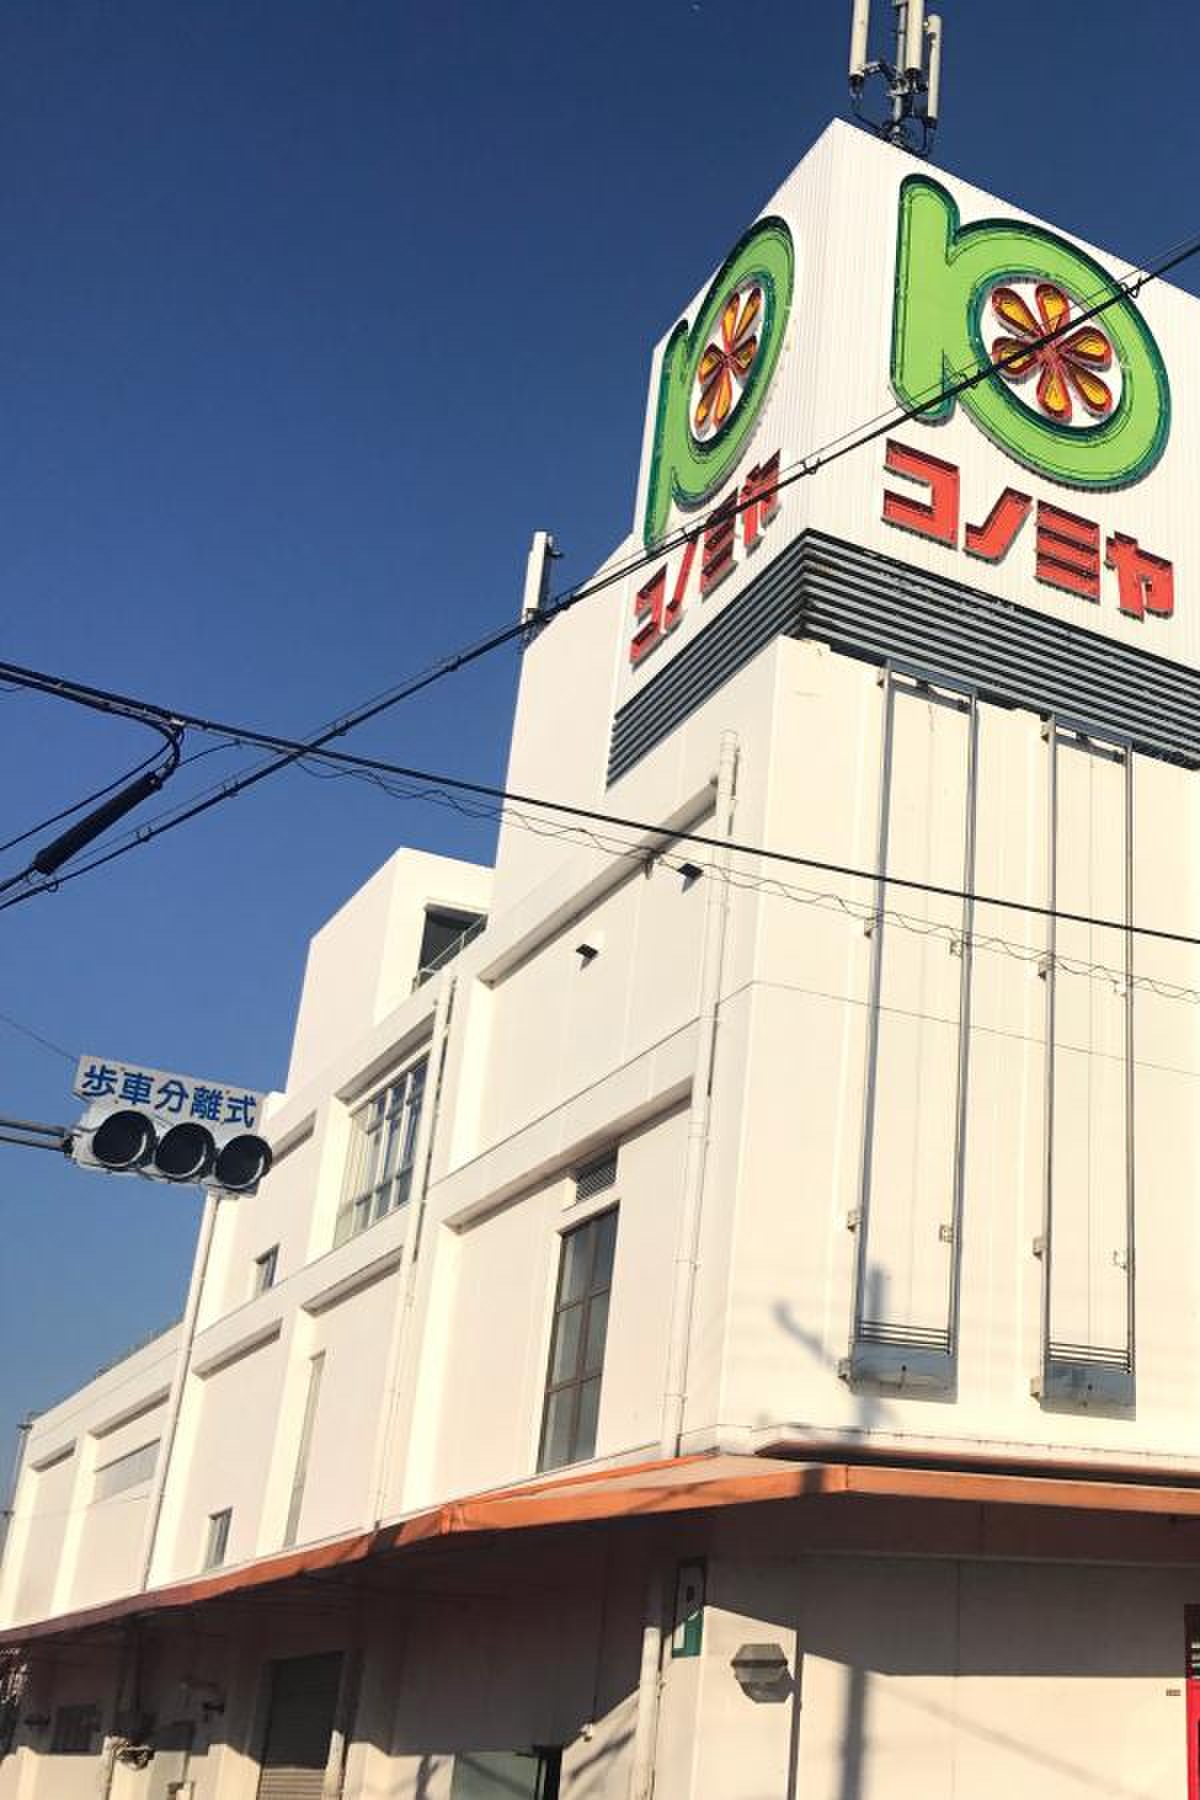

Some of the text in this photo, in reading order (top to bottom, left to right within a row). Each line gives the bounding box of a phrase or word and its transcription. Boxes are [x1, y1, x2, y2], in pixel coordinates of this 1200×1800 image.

[882, 438, 1174, 620] コノミヤ
[82, 1065, 257, 1128] 歩車分離式
